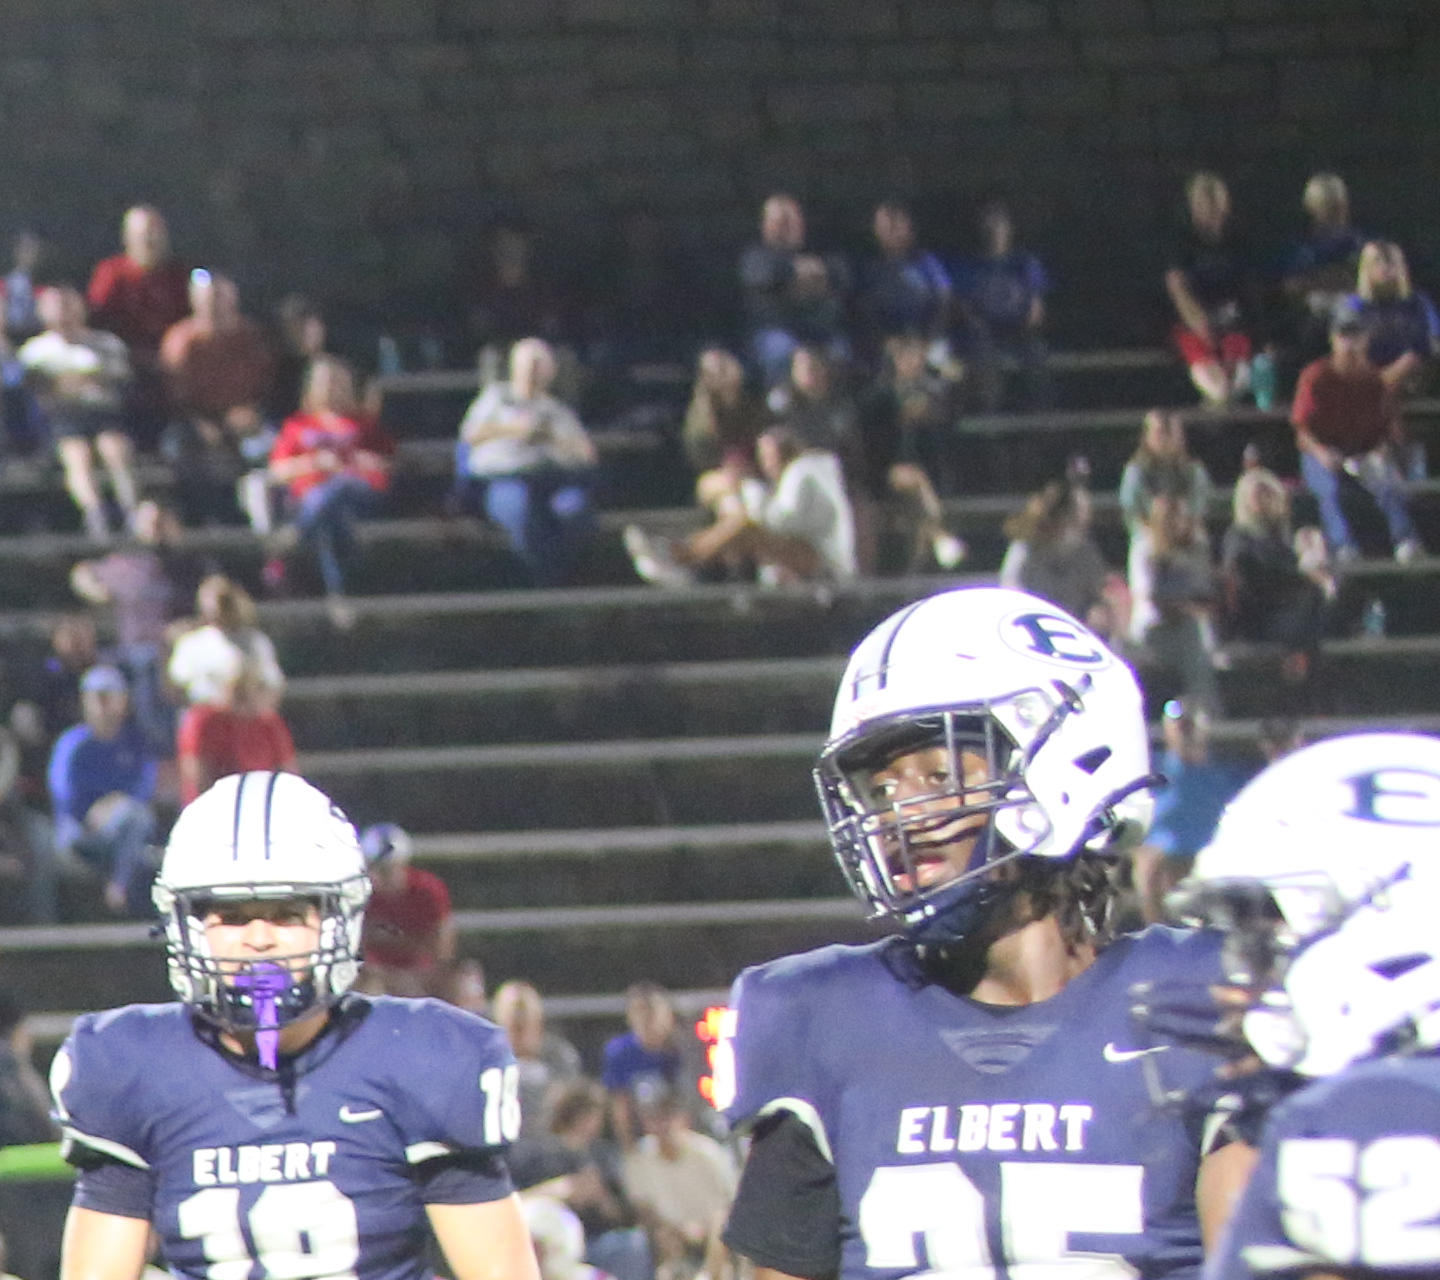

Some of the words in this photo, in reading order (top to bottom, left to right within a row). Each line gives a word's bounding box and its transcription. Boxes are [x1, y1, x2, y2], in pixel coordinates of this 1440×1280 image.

[896, 1103, 1093, 1154] ELBERT
[192, 1141, 336, 1186] ELBERT
[1277, 1135, 1440, 1264] 52
